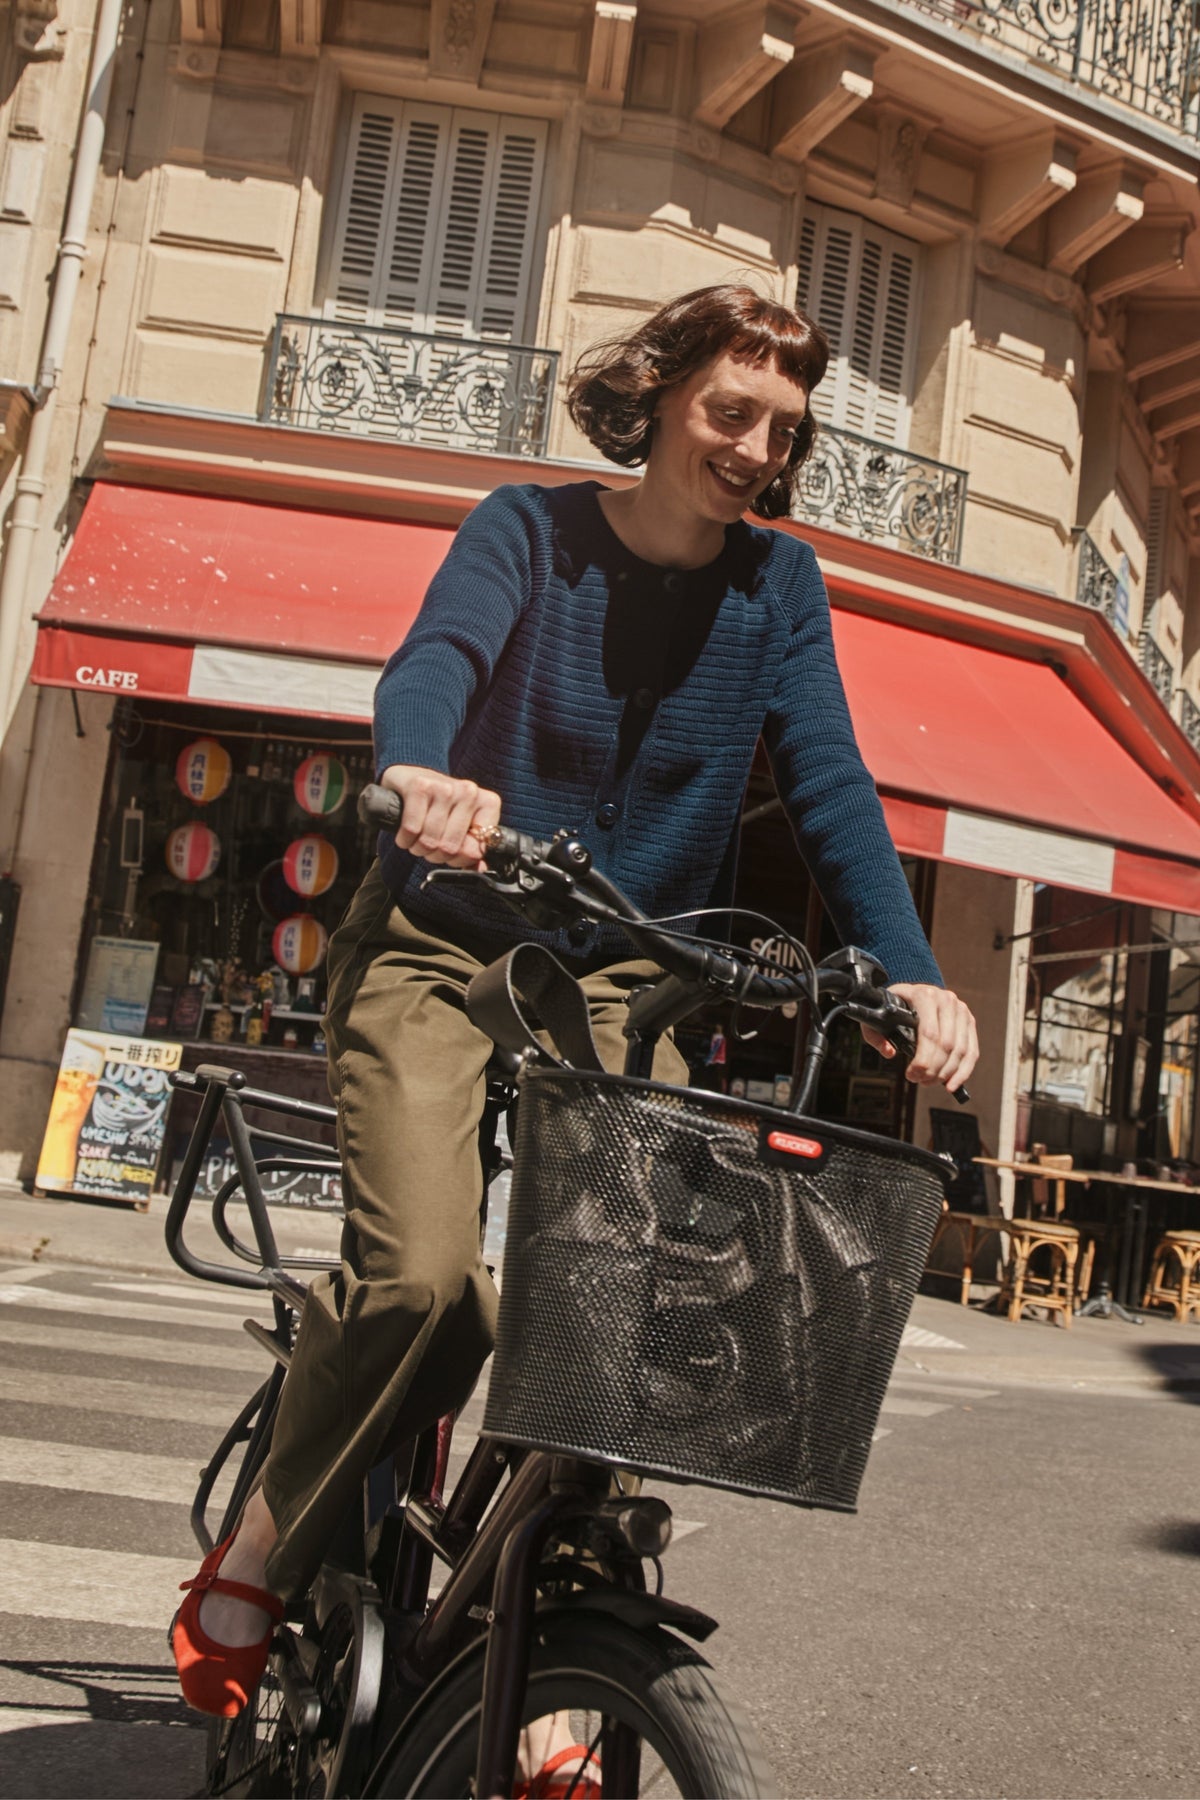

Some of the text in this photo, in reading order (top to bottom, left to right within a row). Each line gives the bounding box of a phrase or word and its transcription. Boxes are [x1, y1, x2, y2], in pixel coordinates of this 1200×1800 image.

[75, 665, 139, 690] CAFE
[109, 1043, 179, 1067] 一番搾り
